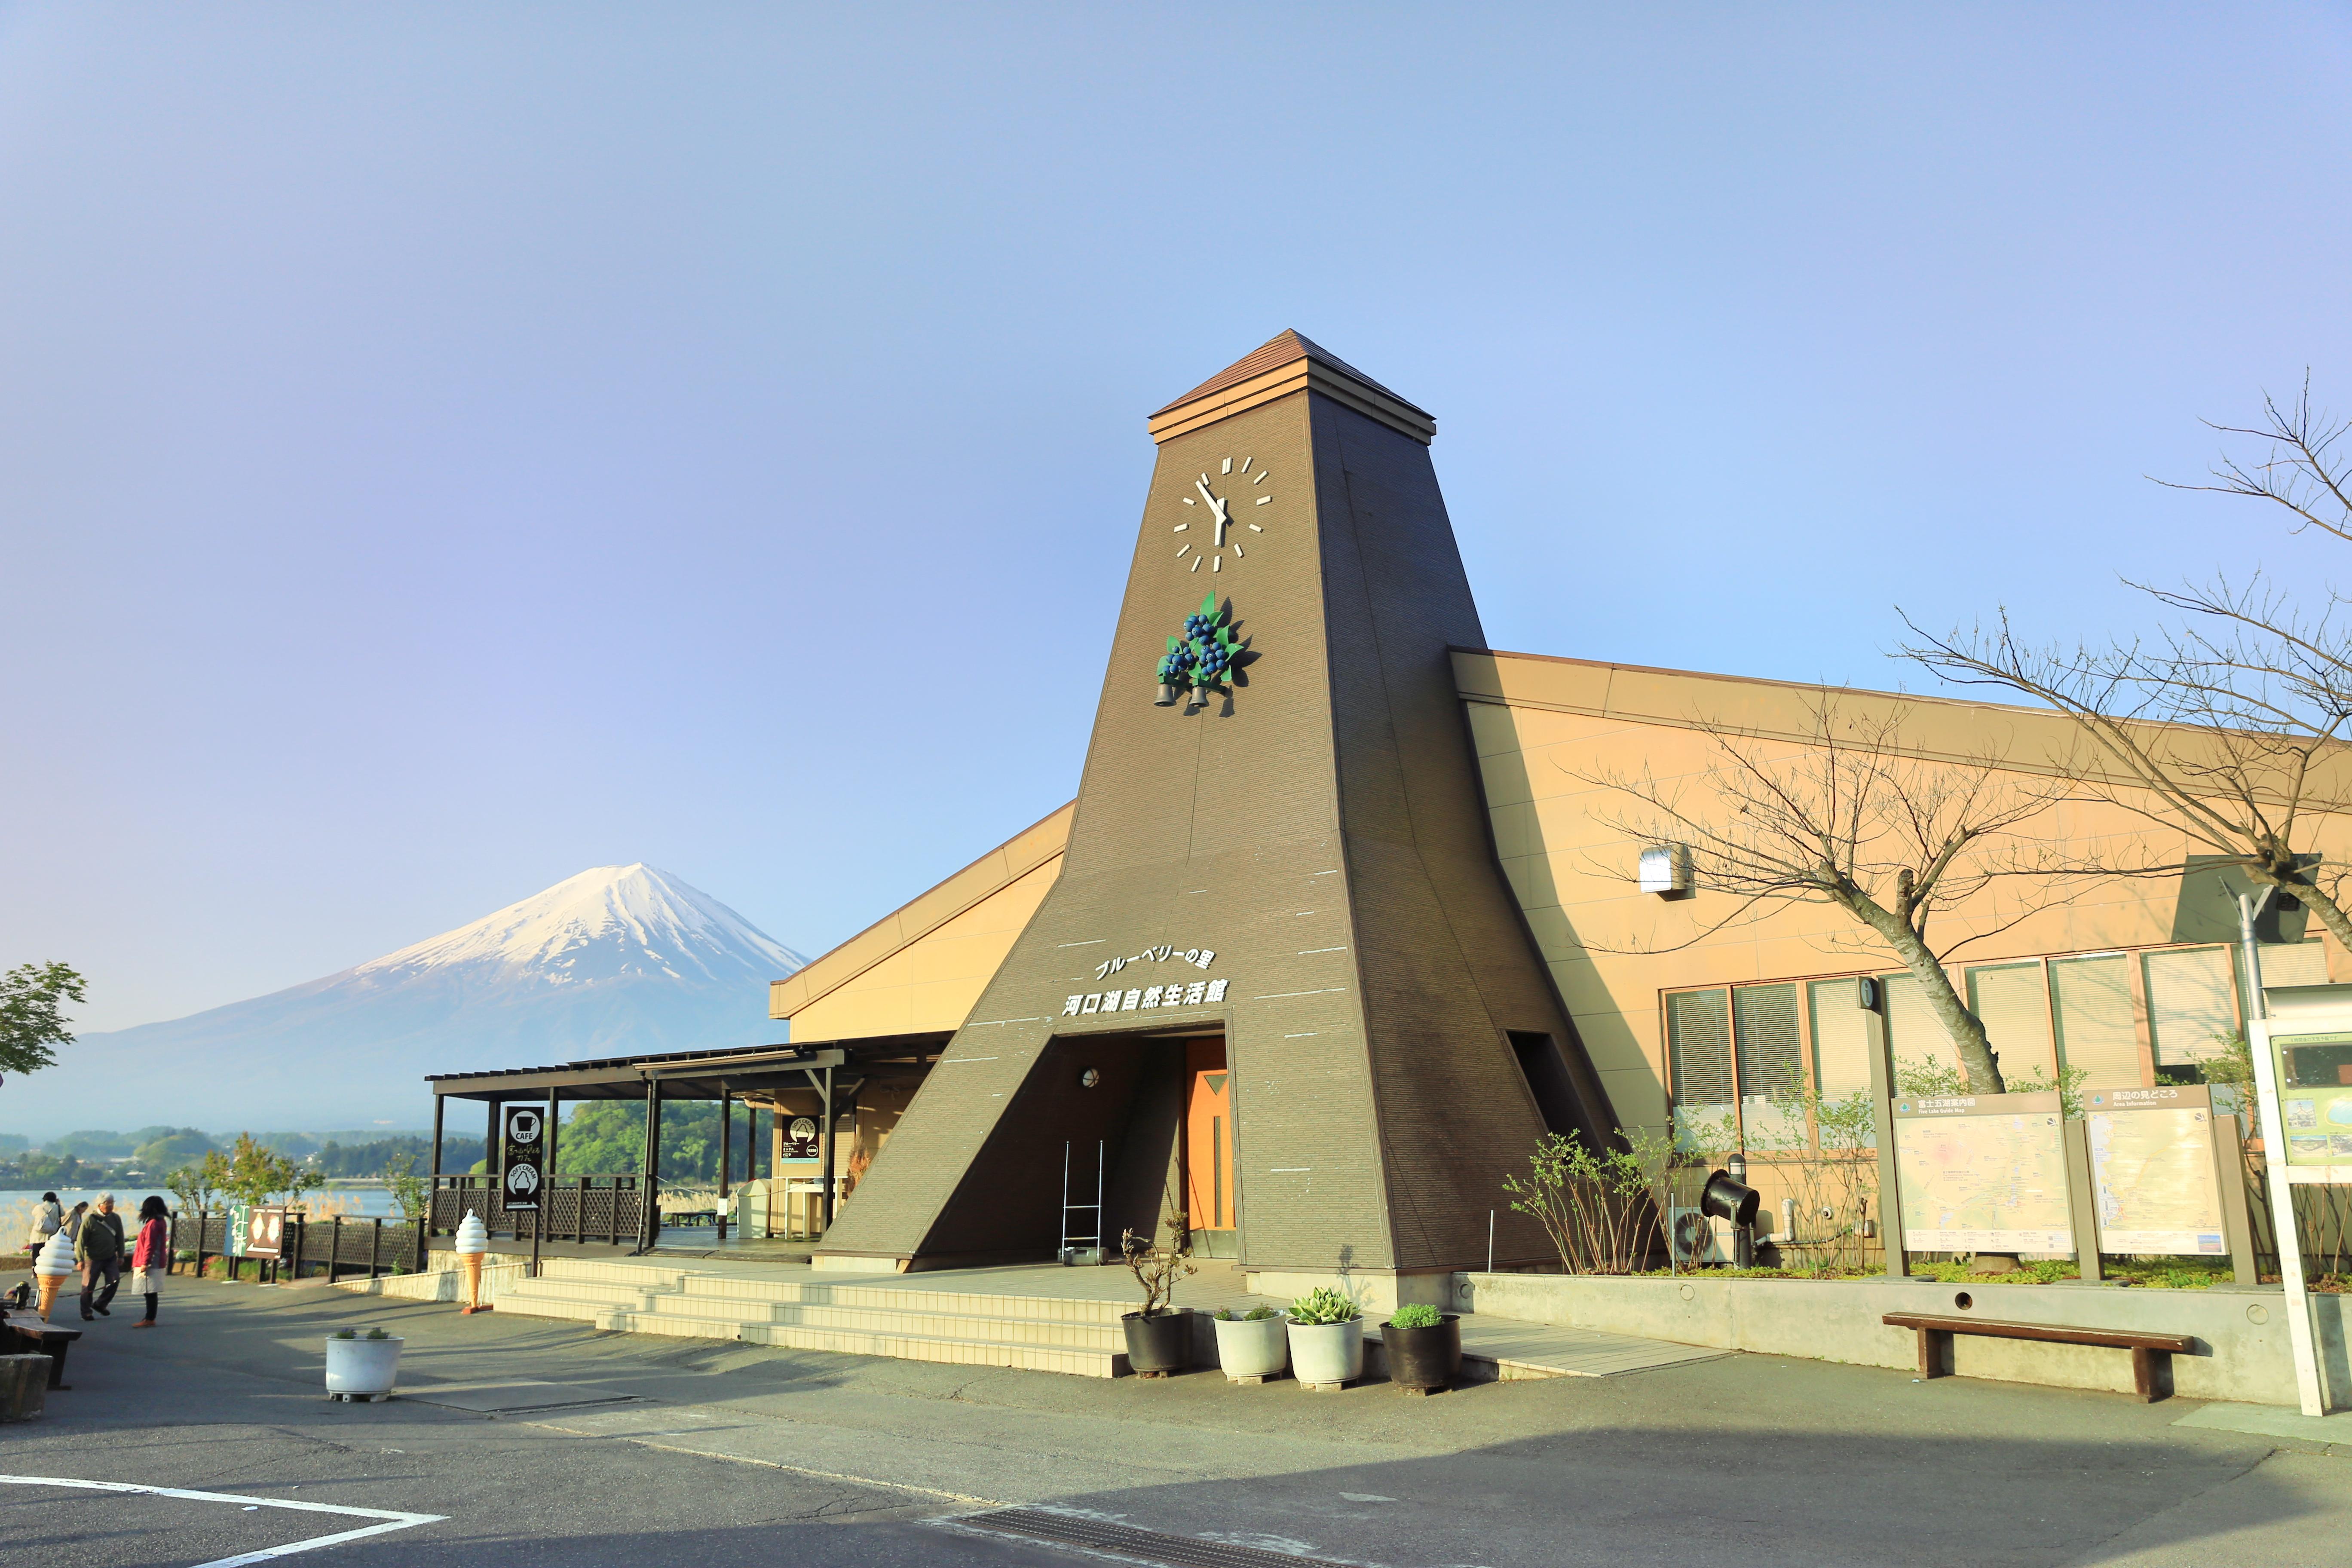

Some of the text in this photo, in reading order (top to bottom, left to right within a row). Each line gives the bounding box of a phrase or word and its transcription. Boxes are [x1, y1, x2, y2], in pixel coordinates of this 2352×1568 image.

[1095, 945, 1216, 981] ブルーベリーの里
[1062, 979, 1228, 1017] 河口湖自然生活館
[2113, 1089, 2178, 1100] 周辺の見どころ
[1918, 1098, 1975, 1108] 富士五湖案内図
[792, 1119, 814, 1130] SOFT CREAM
[511, 1165, 536, 1179] SOFT CREAM
